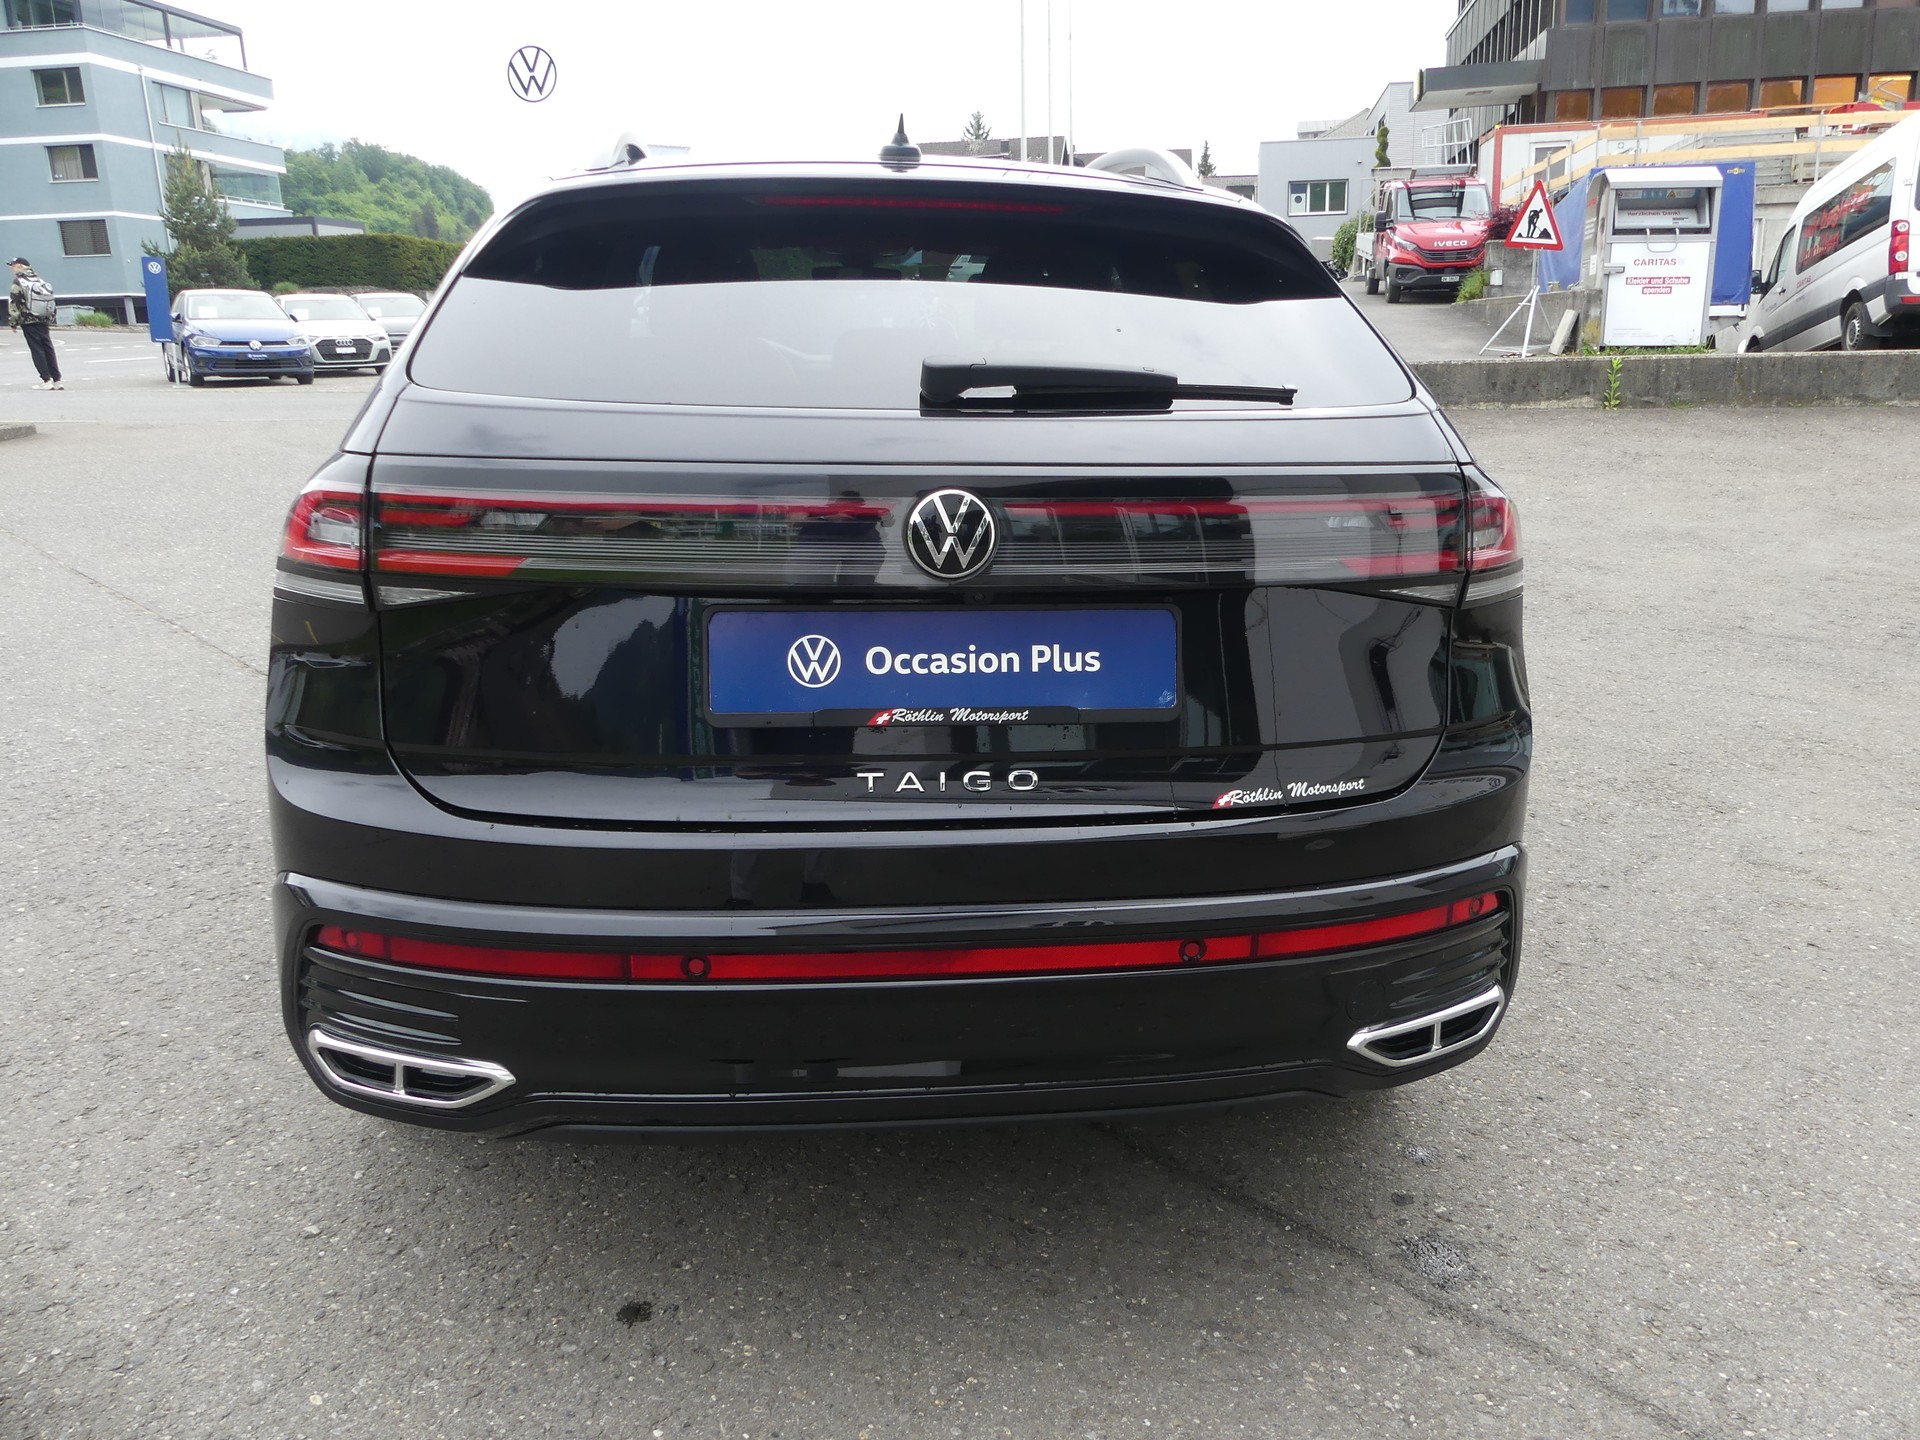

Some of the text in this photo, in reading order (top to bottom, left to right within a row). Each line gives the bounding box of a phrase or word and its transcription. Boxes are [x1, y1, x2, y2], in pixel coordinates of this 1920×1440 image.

[1633, 258, 1677, 266] CARITAS
[1643, 286, 1671, 294] spenden
[907, 489, 995, 578] VW
[787, 634, 1101, 688] VW Occasion Plus
[892, 707, 1029, 724] Röthlin Motorsport
[856, 769, 1039, 793] TAIGO
[1230, 778, 1365, 806] Röthlin Motorsport
